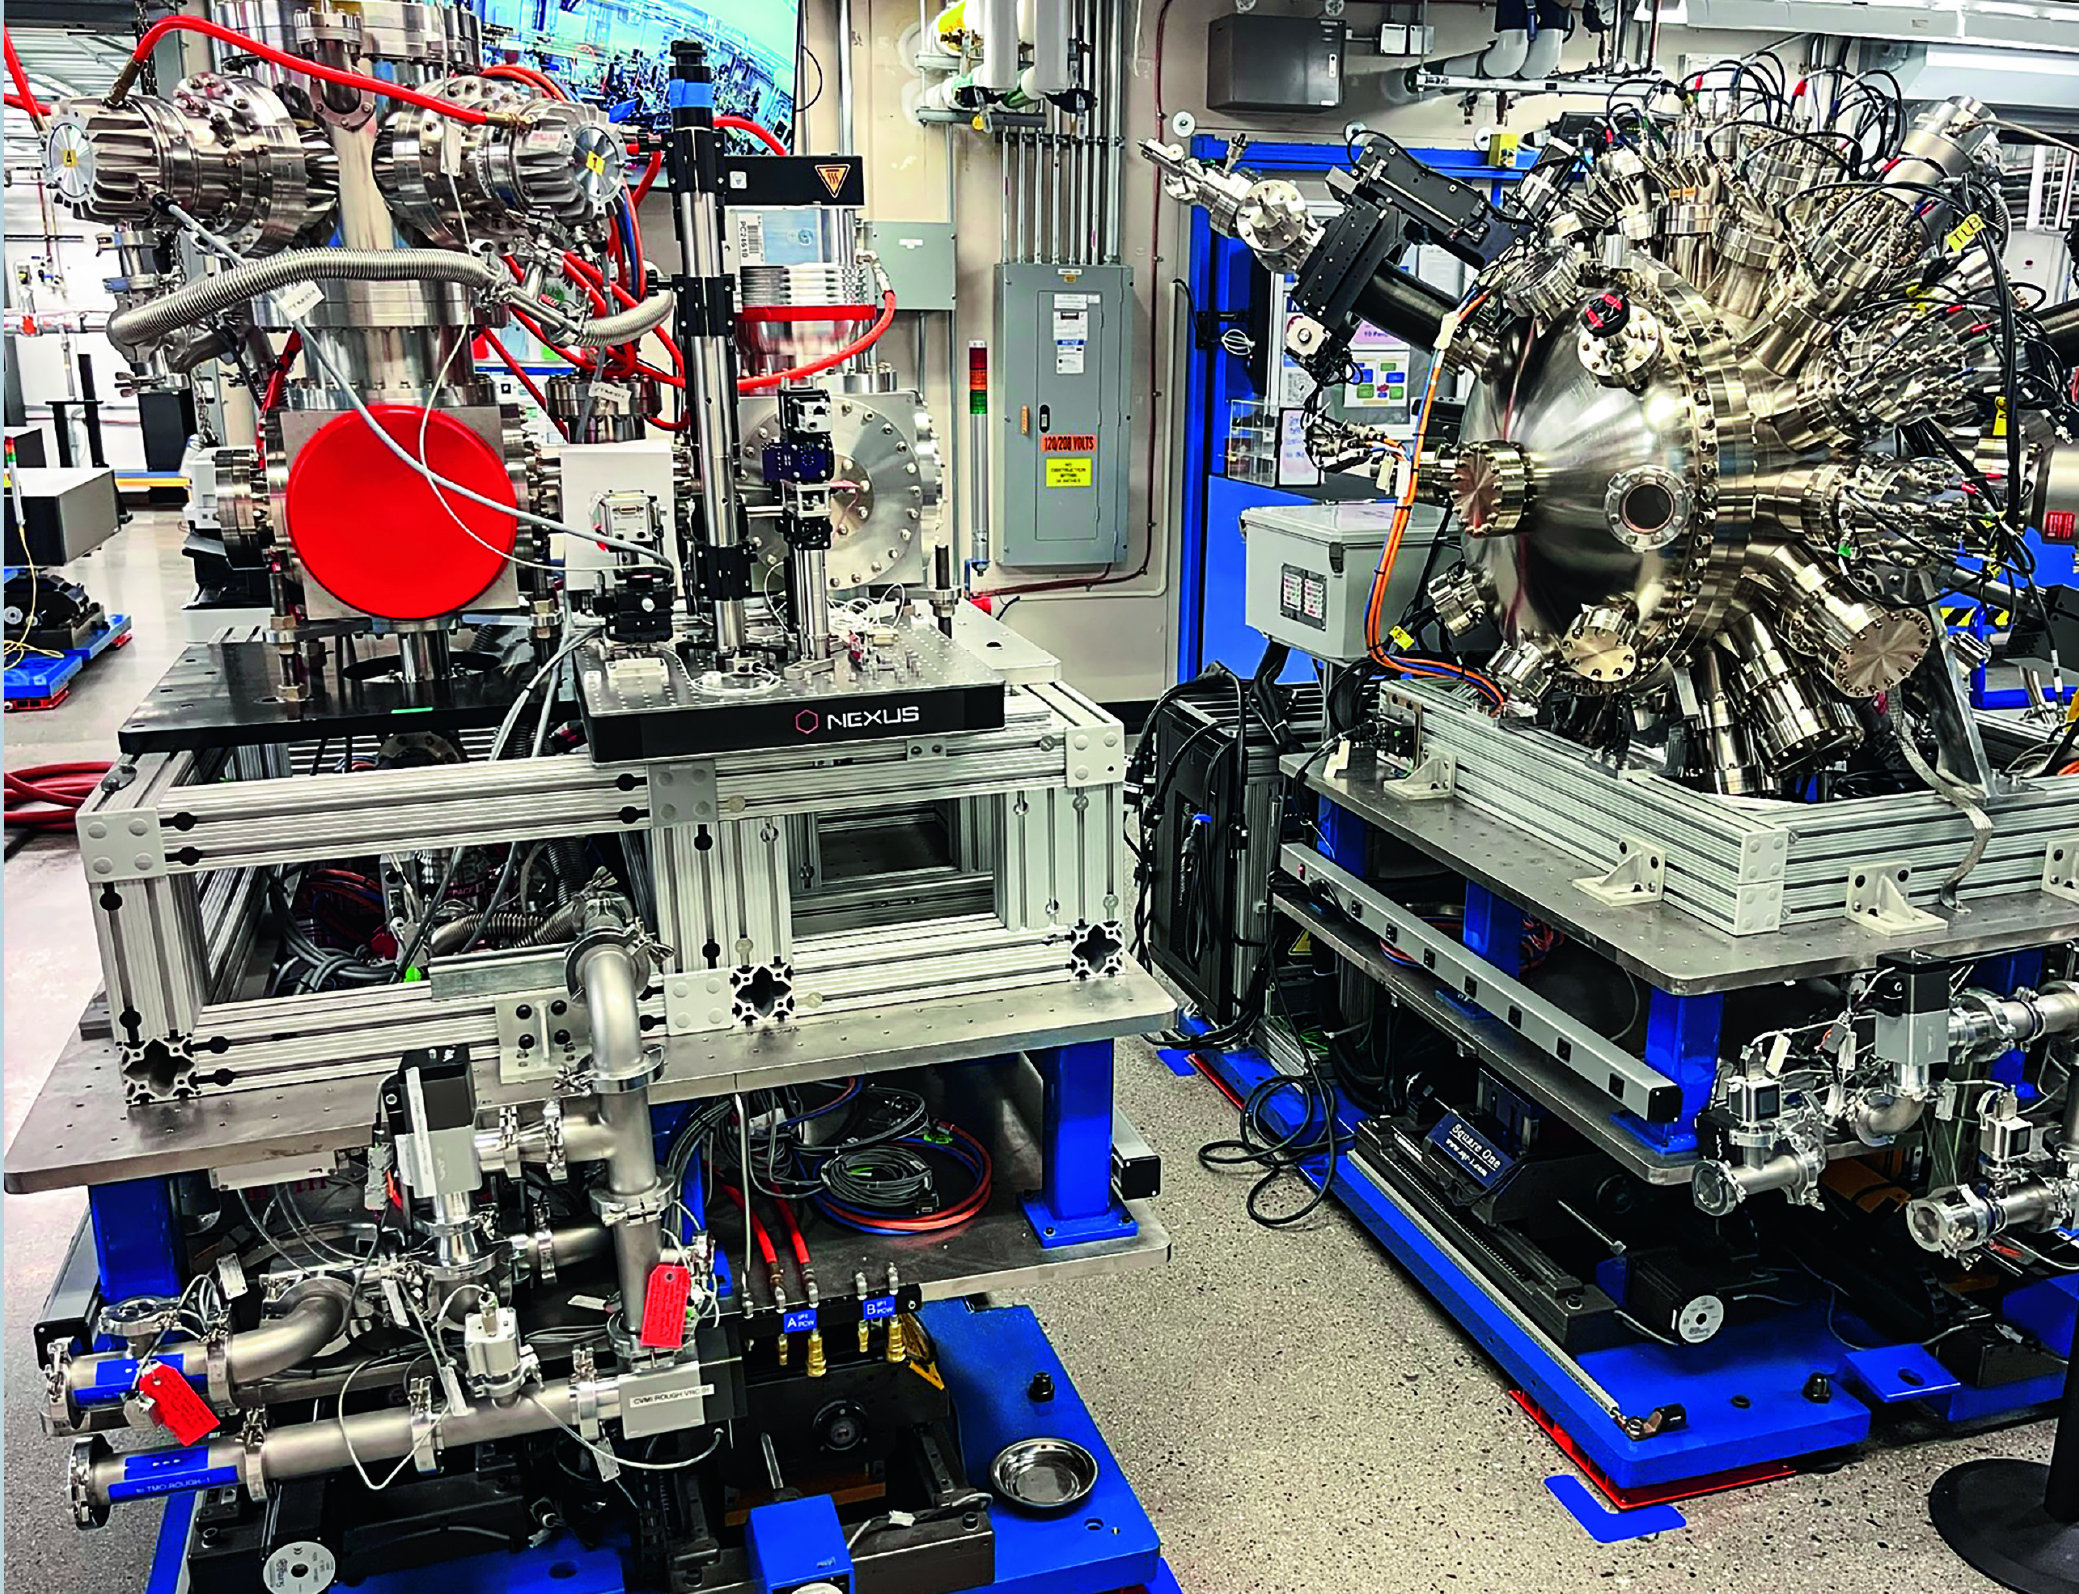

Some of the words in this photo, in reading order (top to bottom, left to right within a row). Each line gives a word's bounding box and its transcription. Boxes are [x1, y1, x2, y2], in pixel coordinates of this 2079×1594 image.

[1950, 216, 1981, 244] TUB
[1044, 436, 1072, 451] 120/208
[1073, 436, 1094, 451] VOLTS
[827, 706, 920, 730] NEXUS
[1451, 1124, 1483, 1152] Square
[1482, 1149, 1501, 1169] One
[867, 1304, 876, 1315] B
[787, 1317, 797, 1328] A
[654, 1392, 682, 1402] ROUGH
[683, 1388, 700, 1397] VRC
[147, 1484, 166, 1492] TMO
